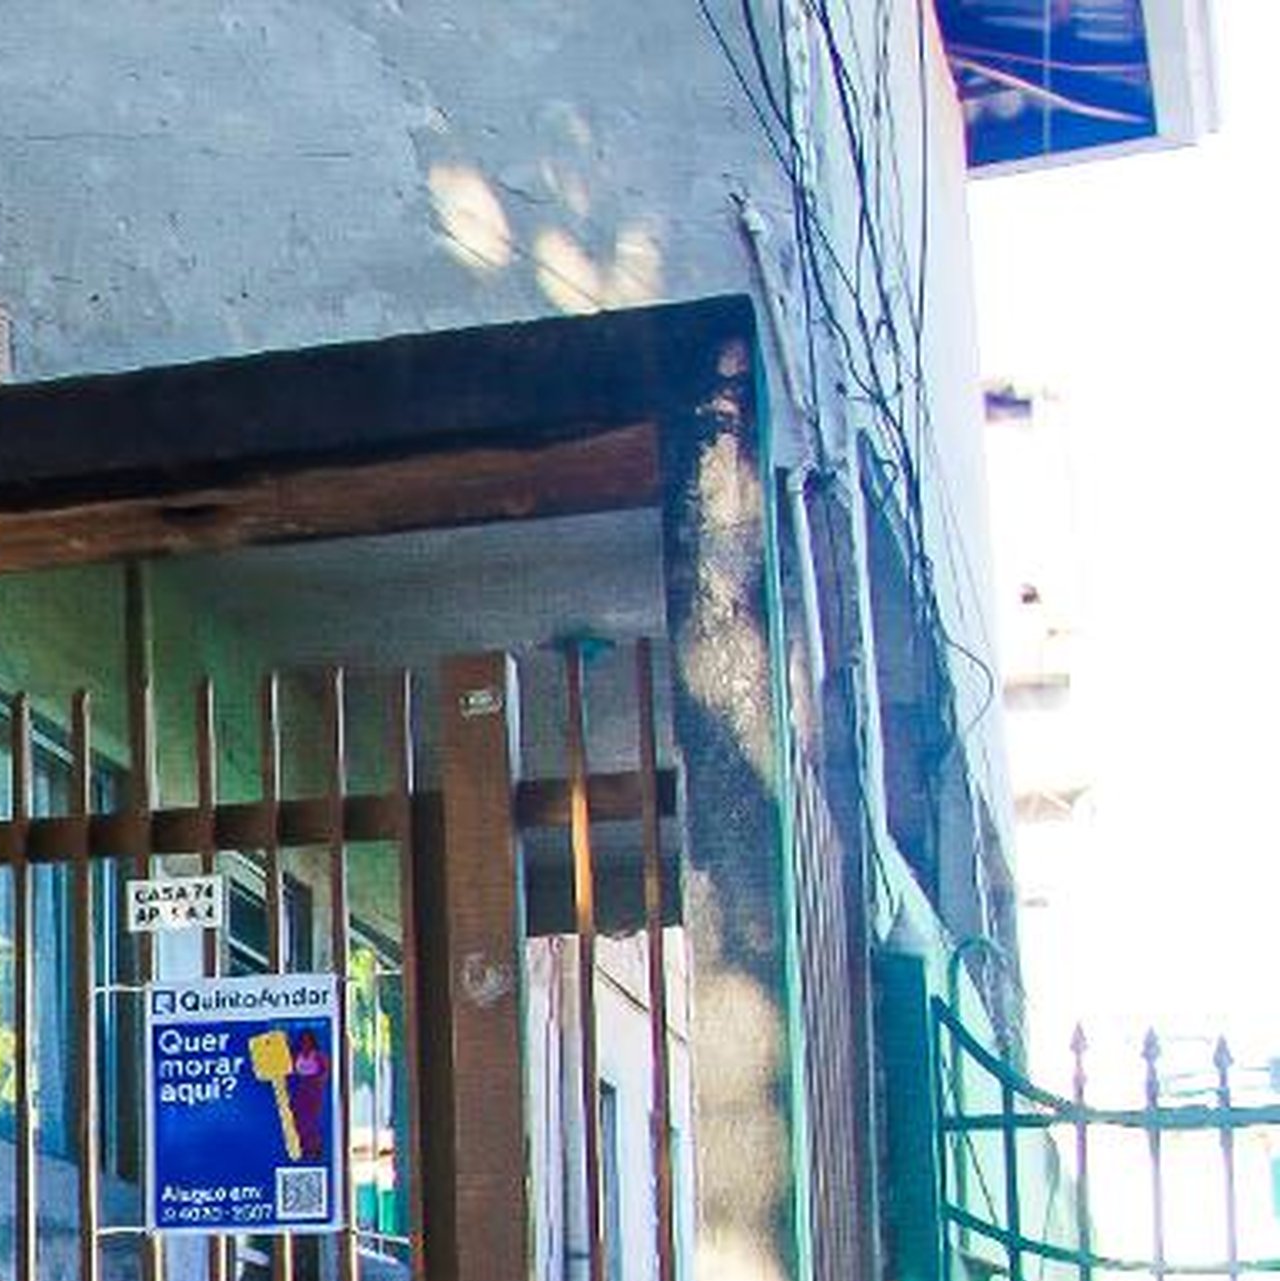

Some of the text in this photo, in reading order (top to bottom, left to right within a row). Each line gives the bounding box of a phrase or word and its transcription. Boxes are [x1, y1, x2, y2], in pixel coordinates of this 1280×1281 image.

[134, 886, 187, 904] CASA
[180, 987, 330, 1012] QuintoAndar
[158, 1029, 230, 1055] Quer
[159, 1056, 245, 1078] morar
[160, 1077, 239, 1105] aqui?
